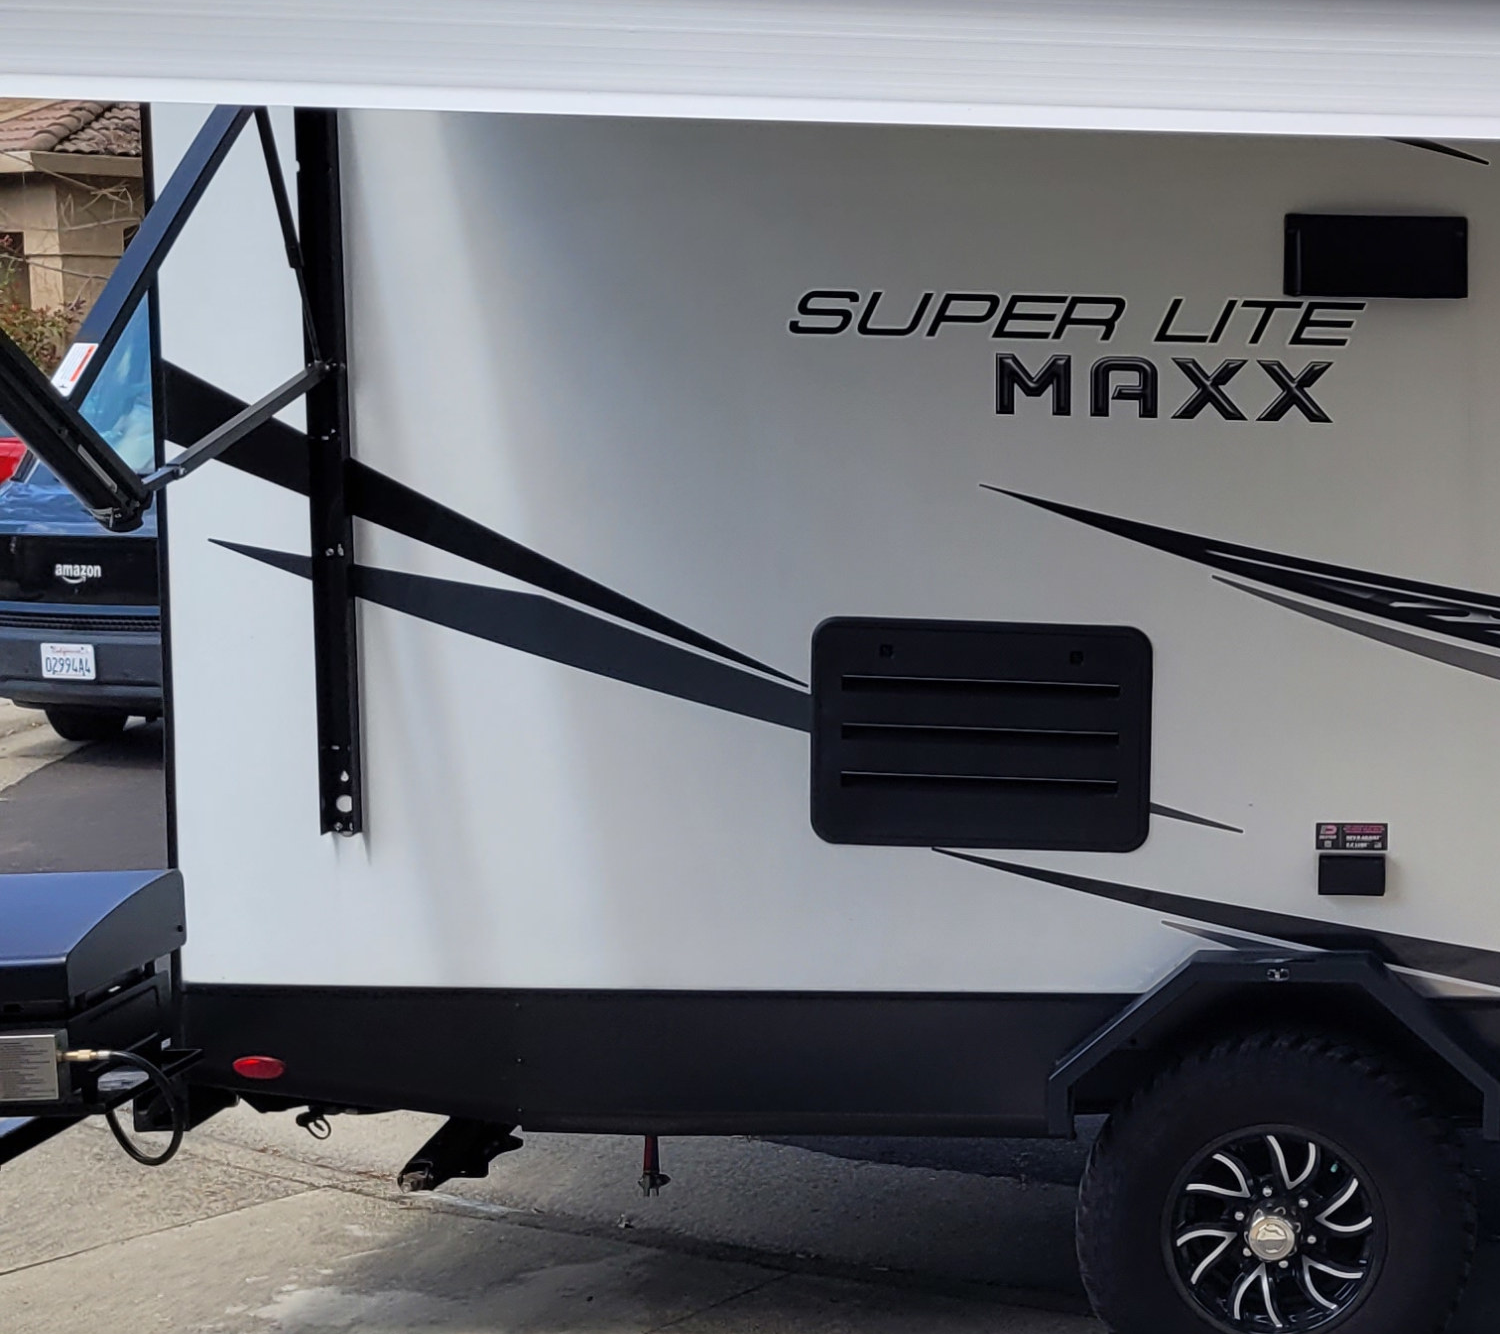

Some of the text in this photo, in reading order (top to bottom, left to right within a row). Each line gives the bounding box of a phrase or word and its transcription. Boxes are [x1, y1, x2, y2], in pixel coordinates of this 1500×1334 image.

[787, 289, 1367, 347] SUPER LITE
[995, 352, 1334, 424] MAXX
[55, 564, 101, 578] amazon
